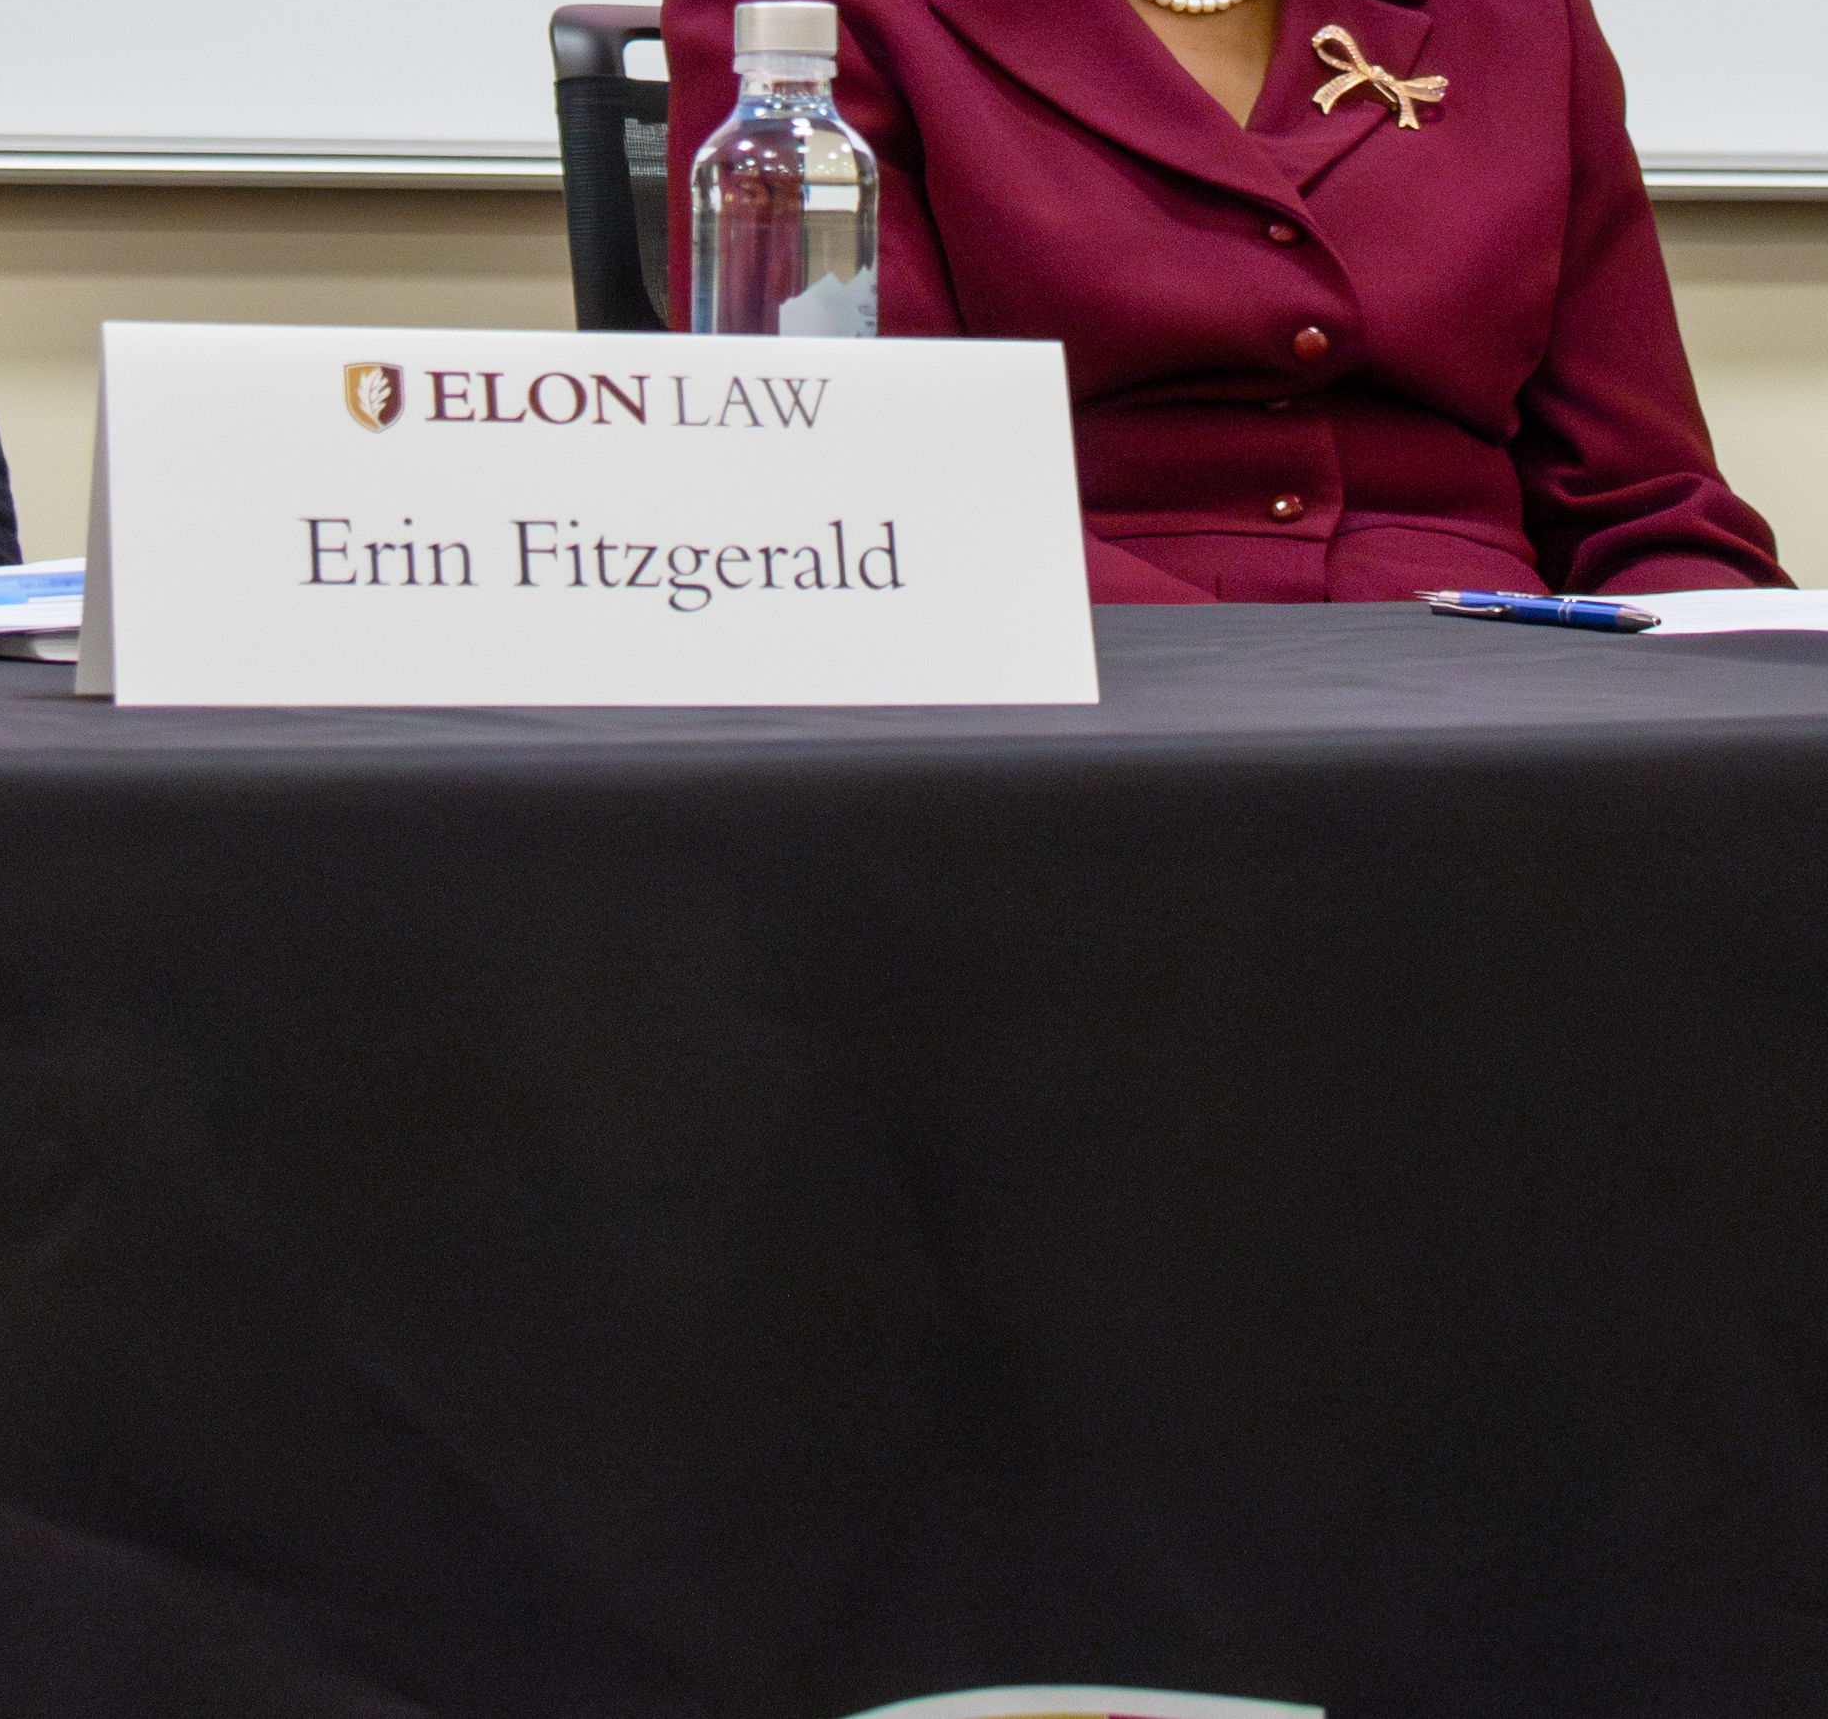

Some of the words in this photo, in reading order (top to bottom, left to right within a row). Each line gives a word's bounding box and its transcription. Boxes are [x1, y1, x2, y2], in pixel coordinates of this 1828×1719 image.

[425, 370, 650, 425] ELON
[671, 375, 831, 429] LAW
[299, 517, 479, 587] Erin
[510, 519, 907, 613] Fitzgerald
